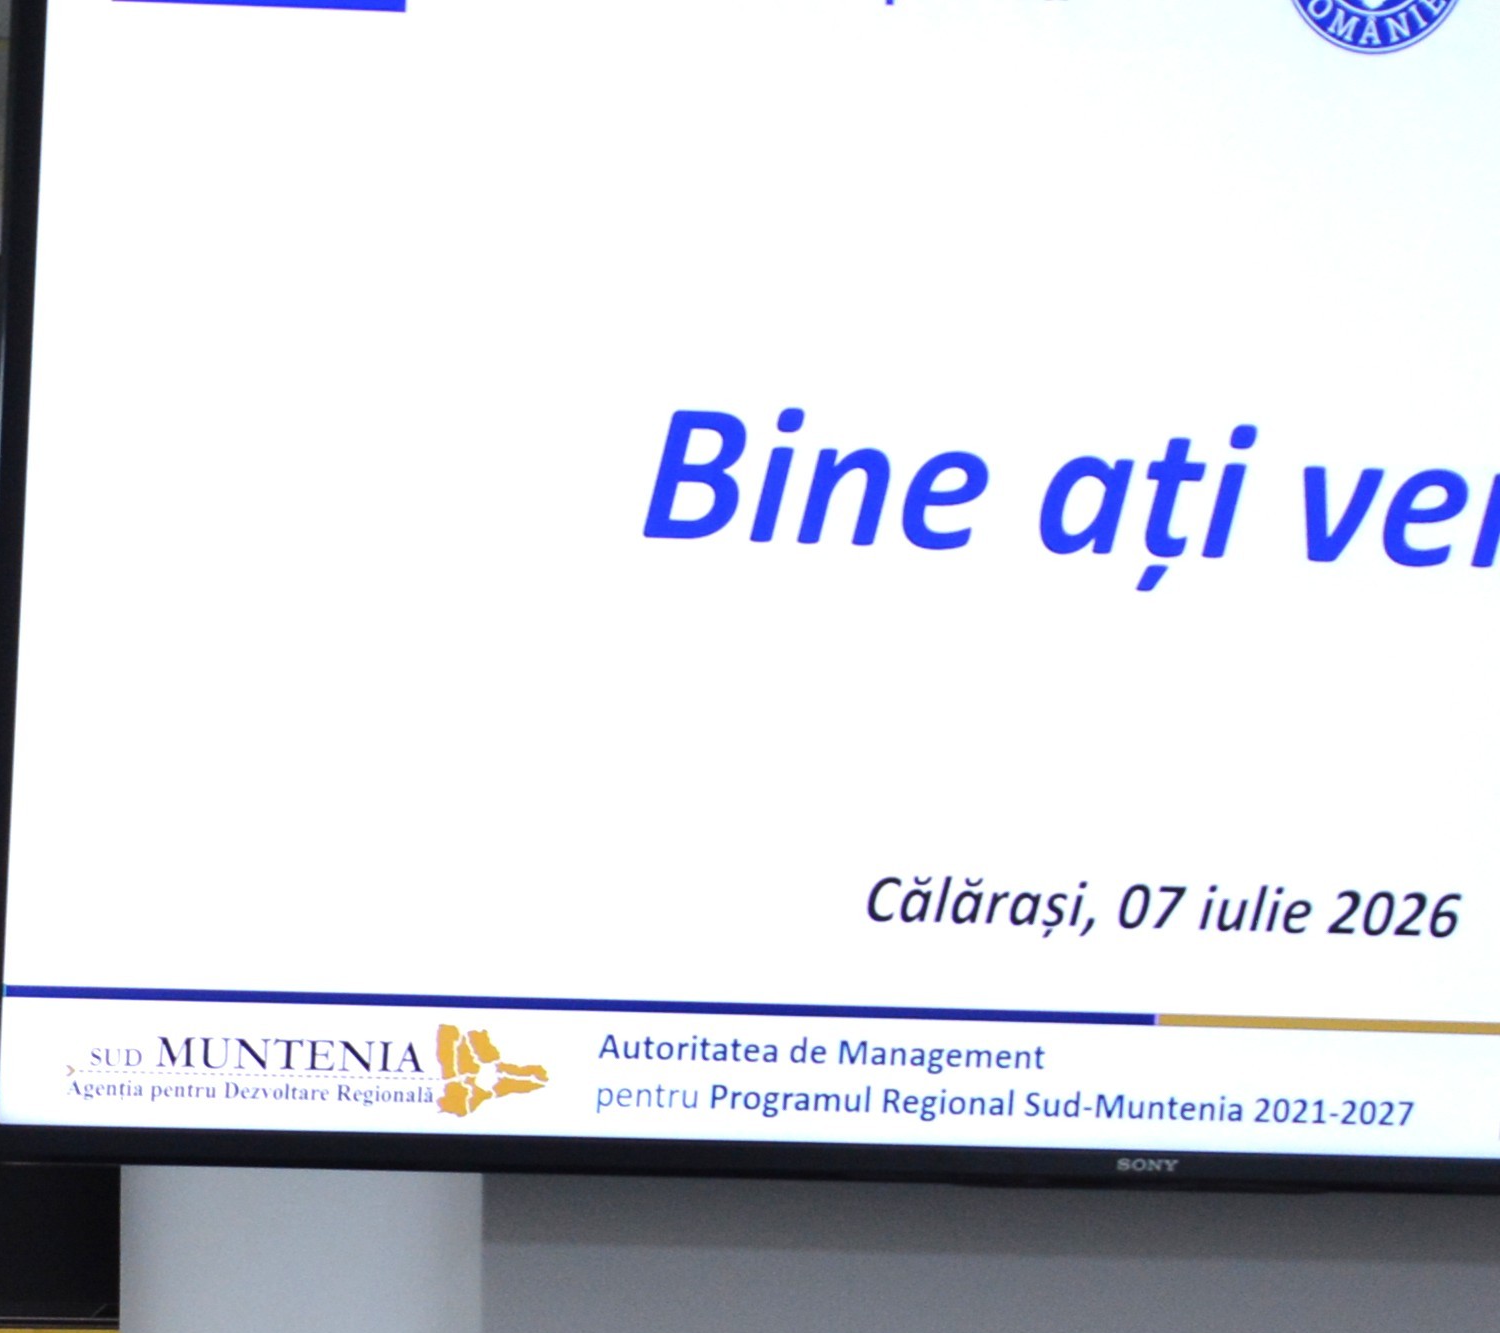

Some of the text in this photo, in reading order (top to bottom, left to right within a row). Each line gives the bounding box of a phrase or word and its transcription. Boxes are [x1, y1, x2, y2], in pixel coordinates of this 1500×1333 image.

[1307, 0, 1446, 45] OMÂNIE
[643, 408, 989, 550] Bine
[1040, 424, 1257, 591] ați
[868, 876, 1462, 938] Călărași, 07 iulie 2026
[91, 1037, 423, 1072] SUD MUNTENIA
[599, 1034, 1045, 1074] Autoritatea de Management
[70, 1080, 433, 1106] Agenția pentru Dezvoltare Regională
[597, 1084, 1414, 1126] pentru Programul Regional Sud-Muntenia 2021-2027
[1117, 1158, 1179, 1172] SONY
